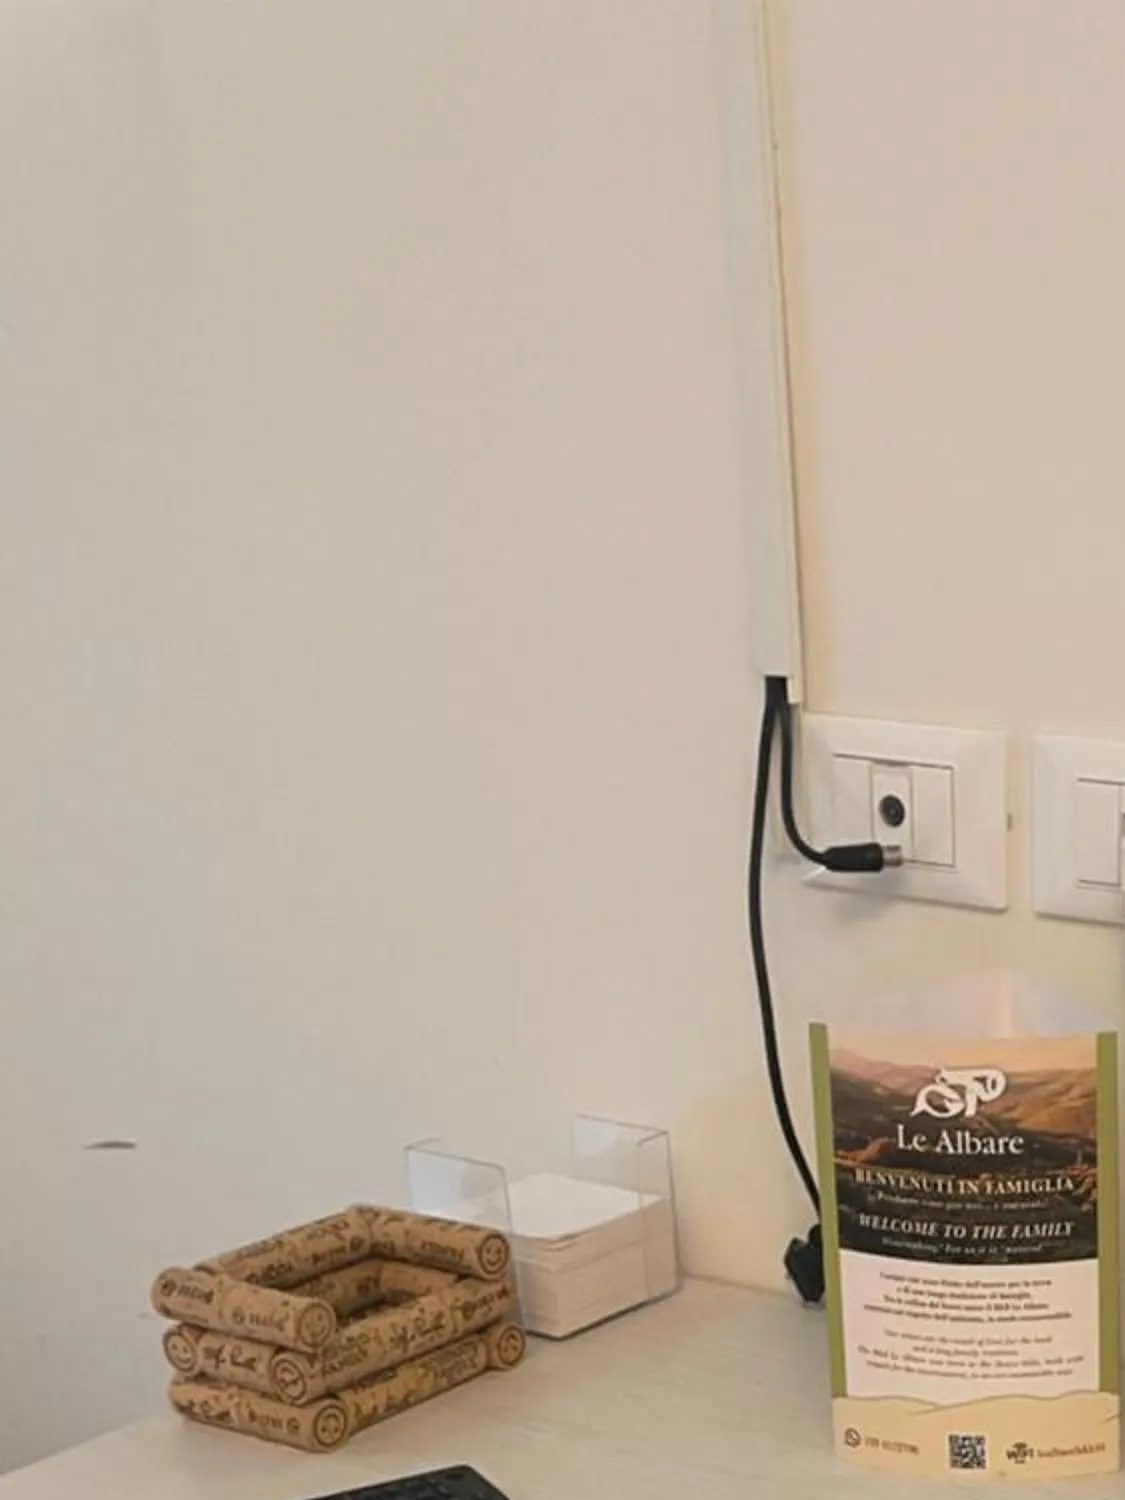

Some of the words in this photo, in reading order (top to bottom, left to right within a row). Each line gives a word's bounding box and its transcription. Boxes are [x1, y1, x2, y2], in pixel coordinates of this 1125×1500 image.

[896, 1123, 927, 1152] Le
[935, 1128, 1025, 1155] Albare
[854, 1167, 953, 1195] BENVENUTI
[958, 1178, 980, 1195] IN
[983, 1176, 1074, 1196] FAMIGLIA
[859, 1212, 938, 1237] WELCOME
[943, 1223, 967, 1239] TO
[972, 1223, 1008, 1240] THE
[1011, 1220, 1075, 1240] FAMILY
